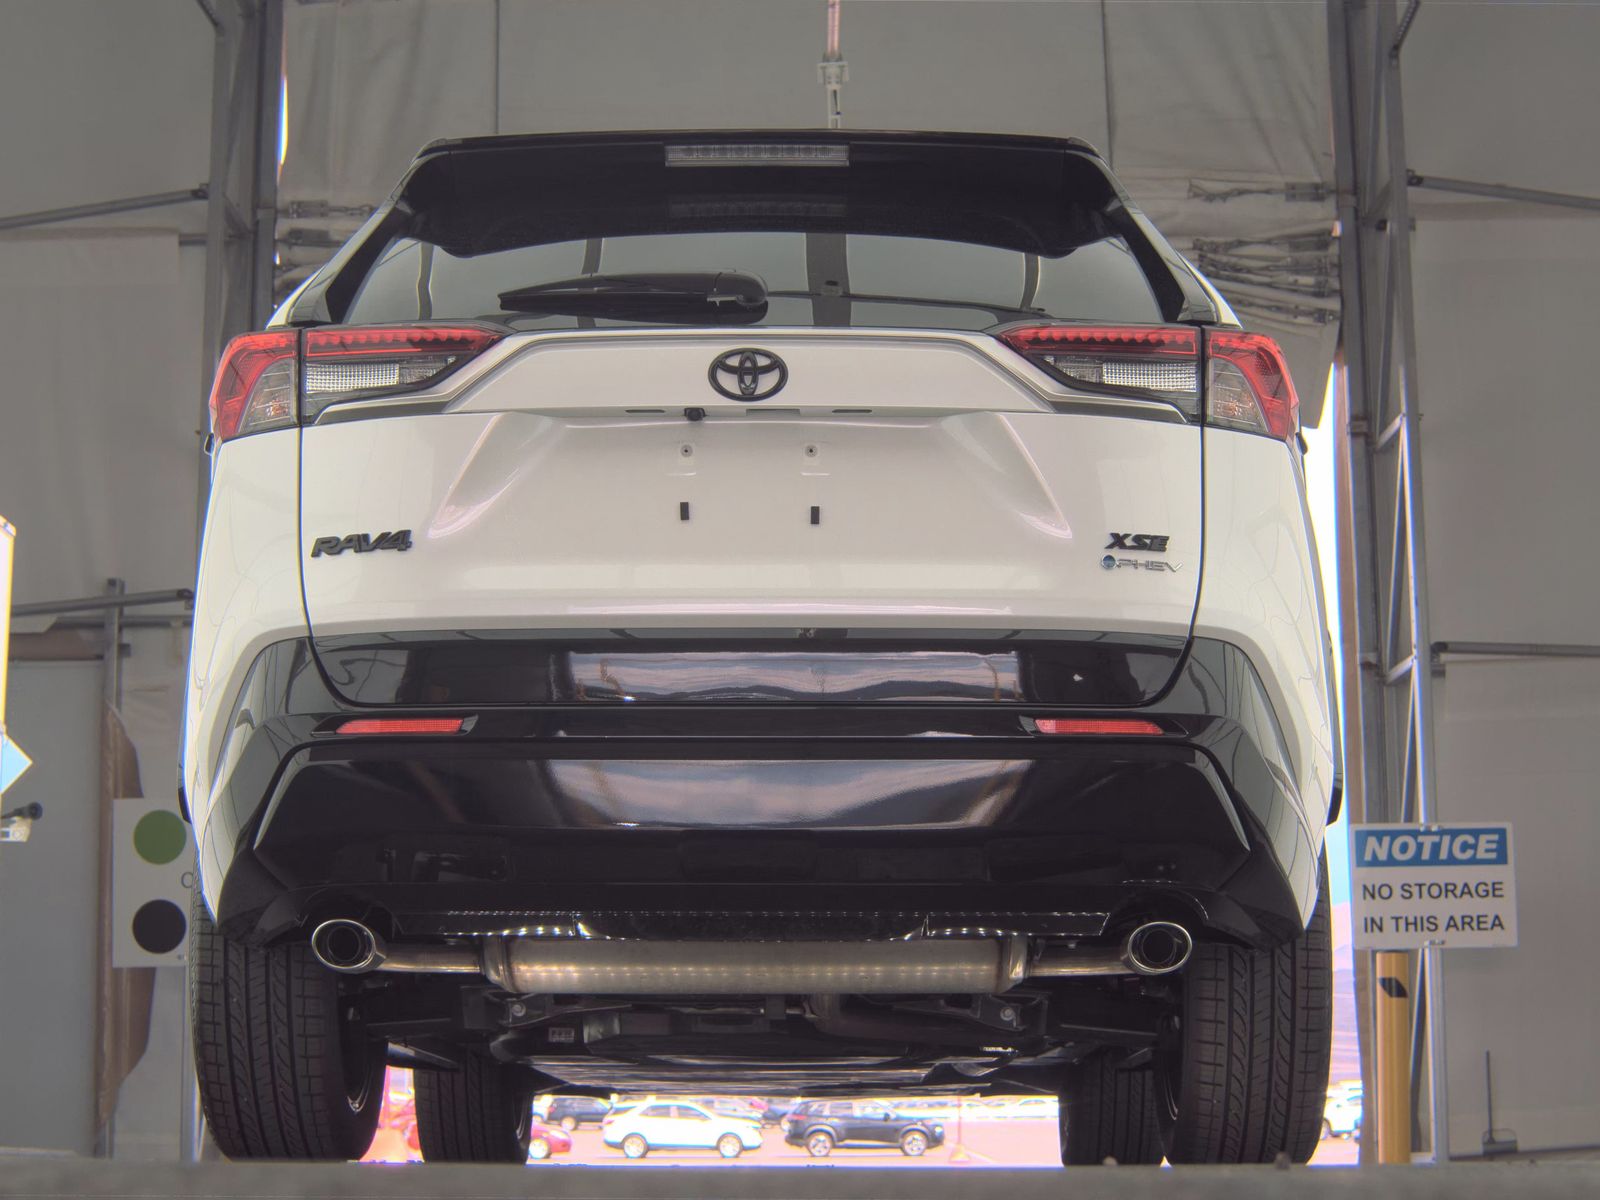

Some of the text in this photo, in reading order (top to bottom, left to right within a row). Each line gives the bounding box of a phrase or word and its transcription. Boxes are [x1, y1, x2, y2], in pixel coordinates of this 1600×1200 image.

[311, 529, 412, 558] RAV4
[1104, 532, 1170, 552] XSE
[1364, 834, 1499, 861] NOTICE
[1362, 881, 1505, 900] NO STORAGE
[1364, 914, 1505, 933] IN THIS AREA
